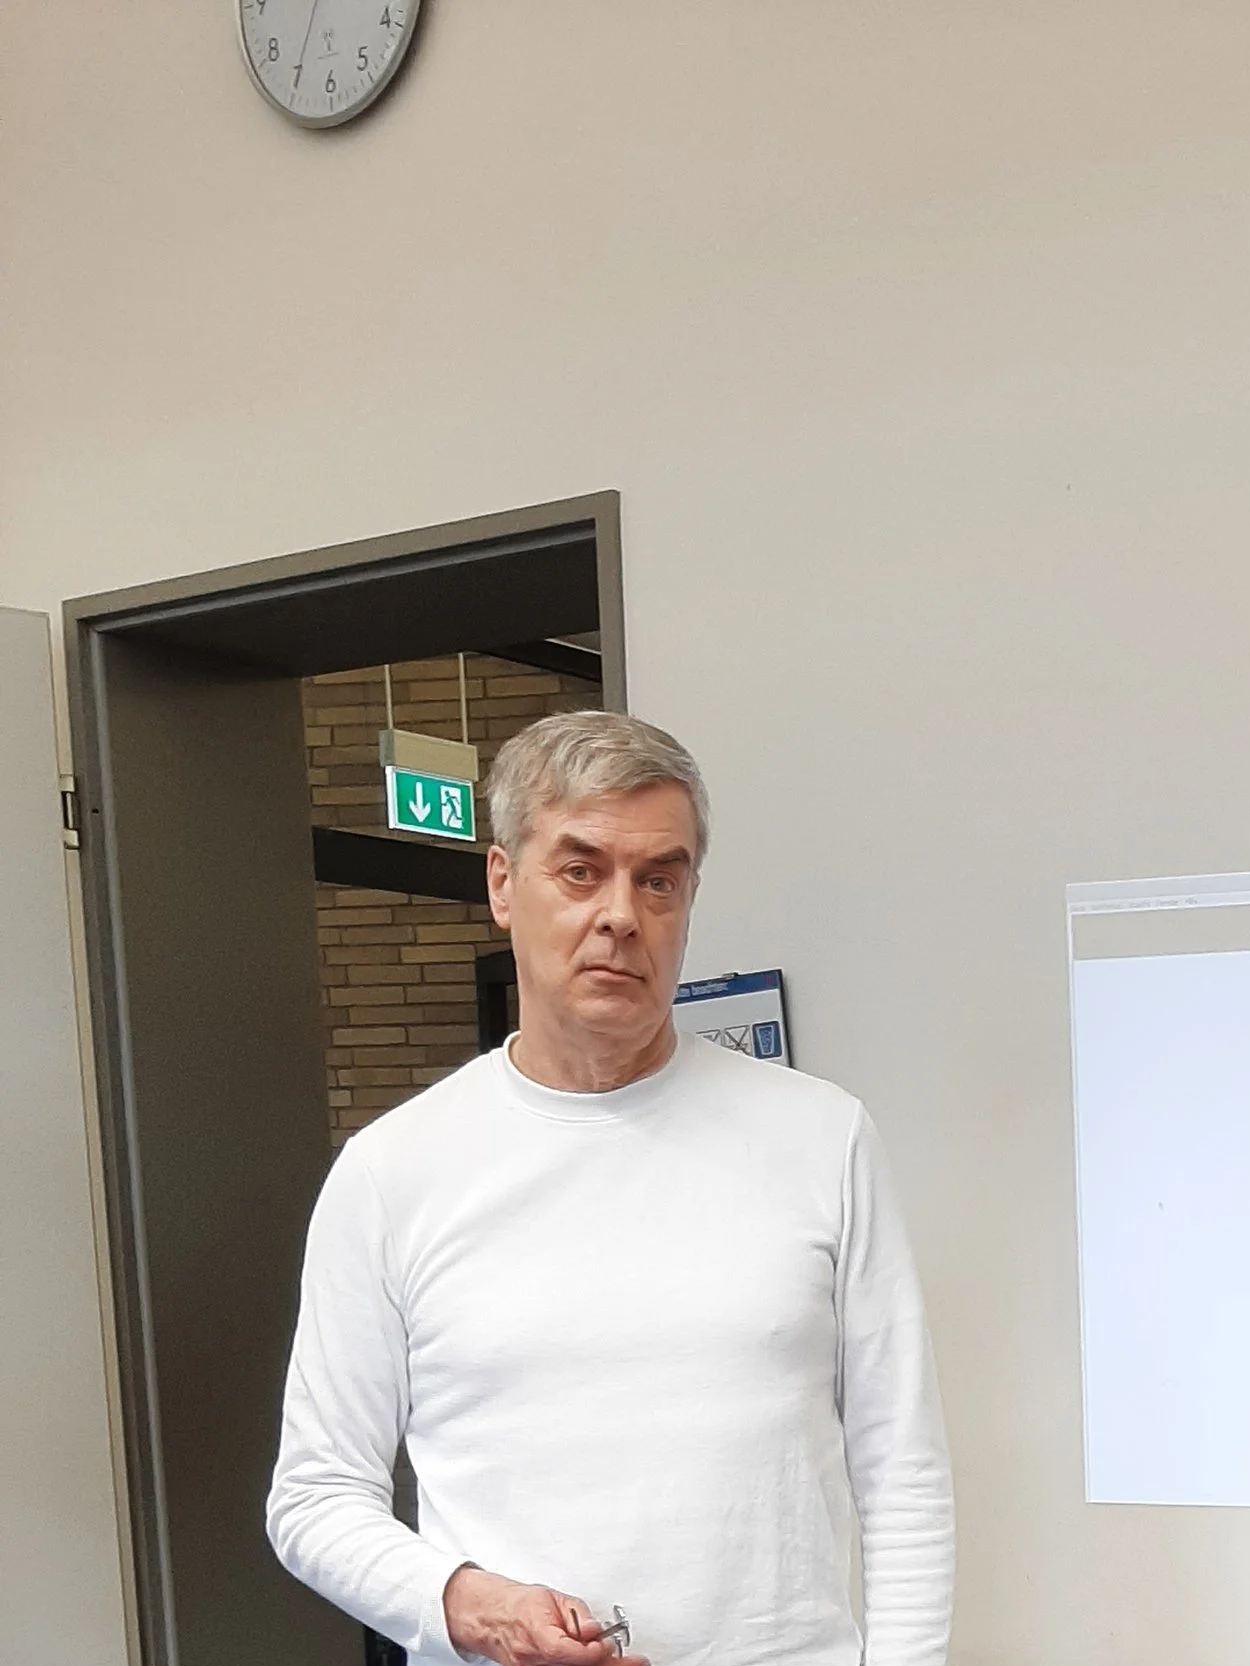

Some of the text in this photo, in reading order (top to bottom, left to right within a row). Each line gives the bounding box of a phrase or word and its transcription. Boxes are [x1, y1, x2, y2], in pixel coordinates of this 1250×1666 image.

[379, 7, 391, 28] 4
[267, 38, 280, 61] 8
[356, 46, 369, 71] 5
[293, 64, 303, 89] 7
[325, 69, 336, 93] 6
